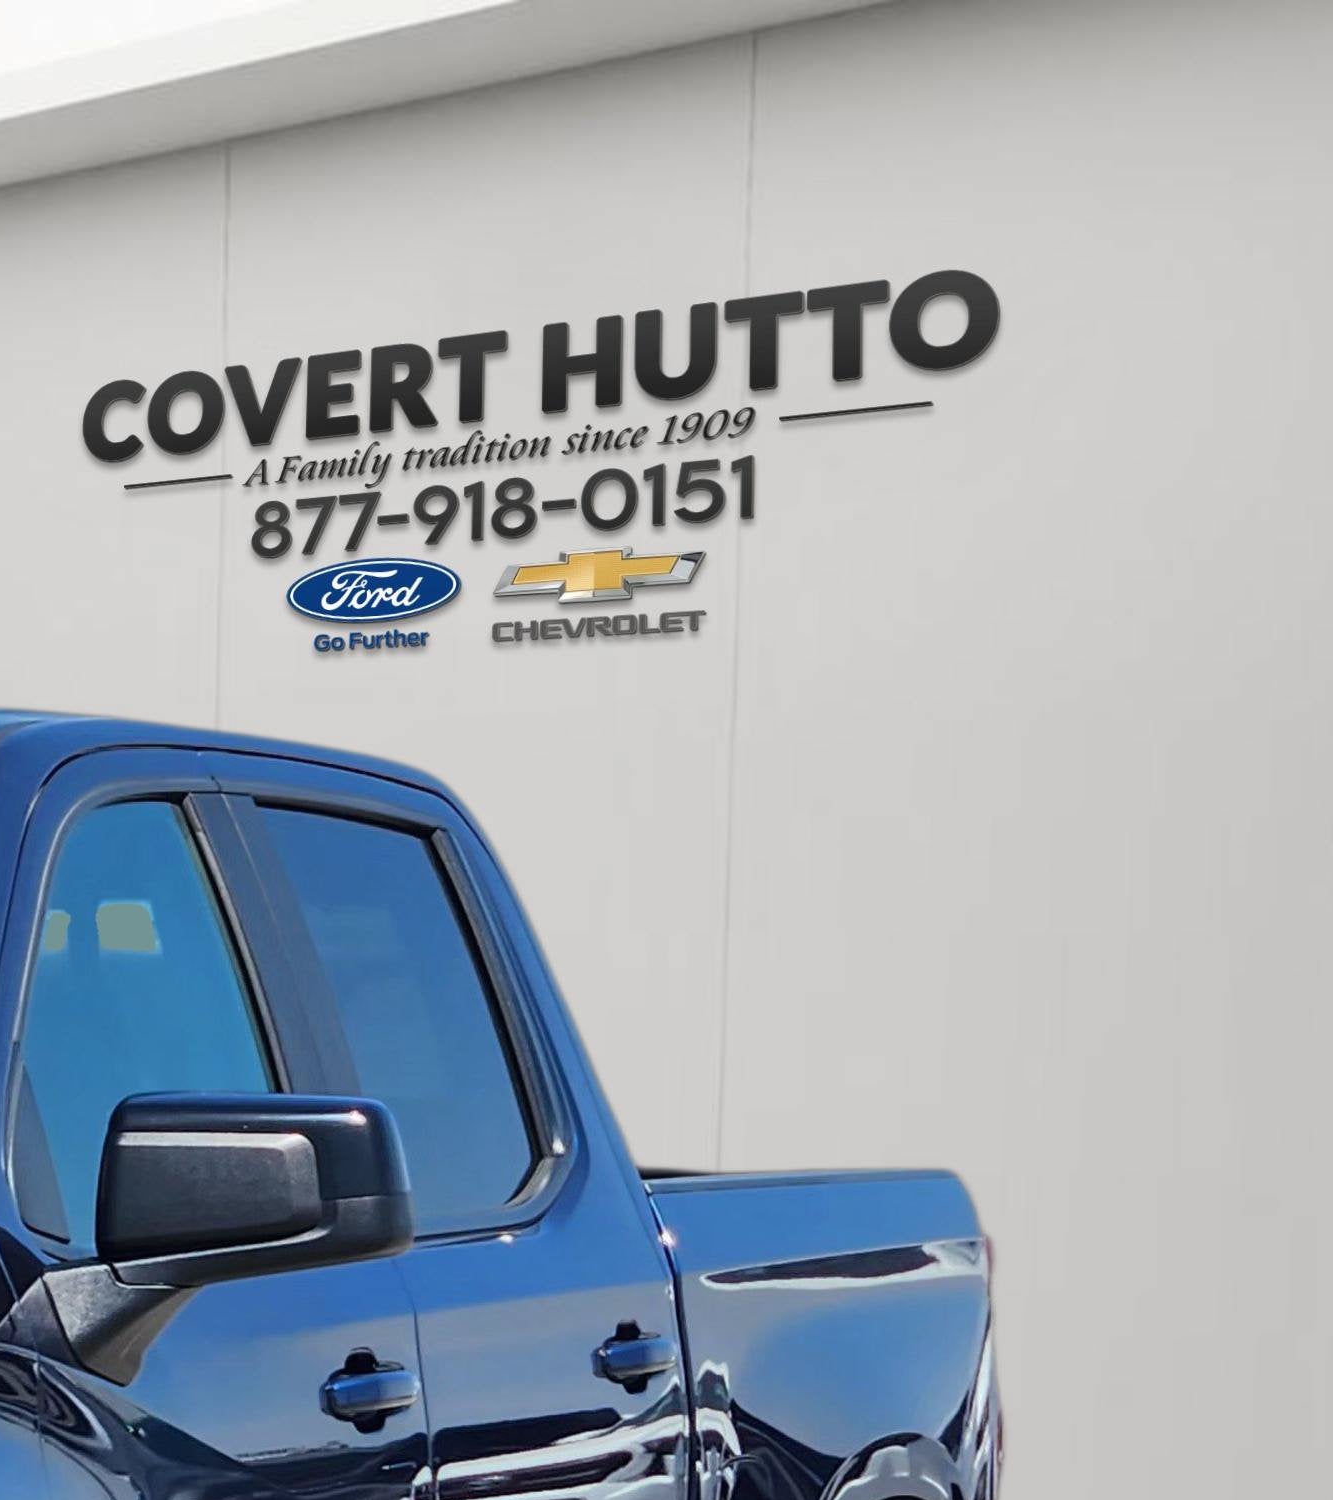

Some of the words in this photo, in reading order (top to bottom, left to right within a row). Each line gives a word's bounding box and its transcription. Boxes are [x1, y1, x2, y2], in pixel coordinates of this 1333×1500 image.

[82, 330, 509, 464] COVERT
[541, 269, 1001, 414] HUTTO
[242, 458, 269, 487] A
[275, 441, 393, 489] Family
[401, 429, 552, 473] tradition
[561, 424, 650, 456] since
[656, 406, 757, 446] 1909
[249, 454, 756, 559] 877-918-0151
[320, 569, 424, 611] Ford
[313, 633, 345, 652] Go
[349, 629, 430, 650] Further
[491, 609, 708, 643] CHEVROLET
